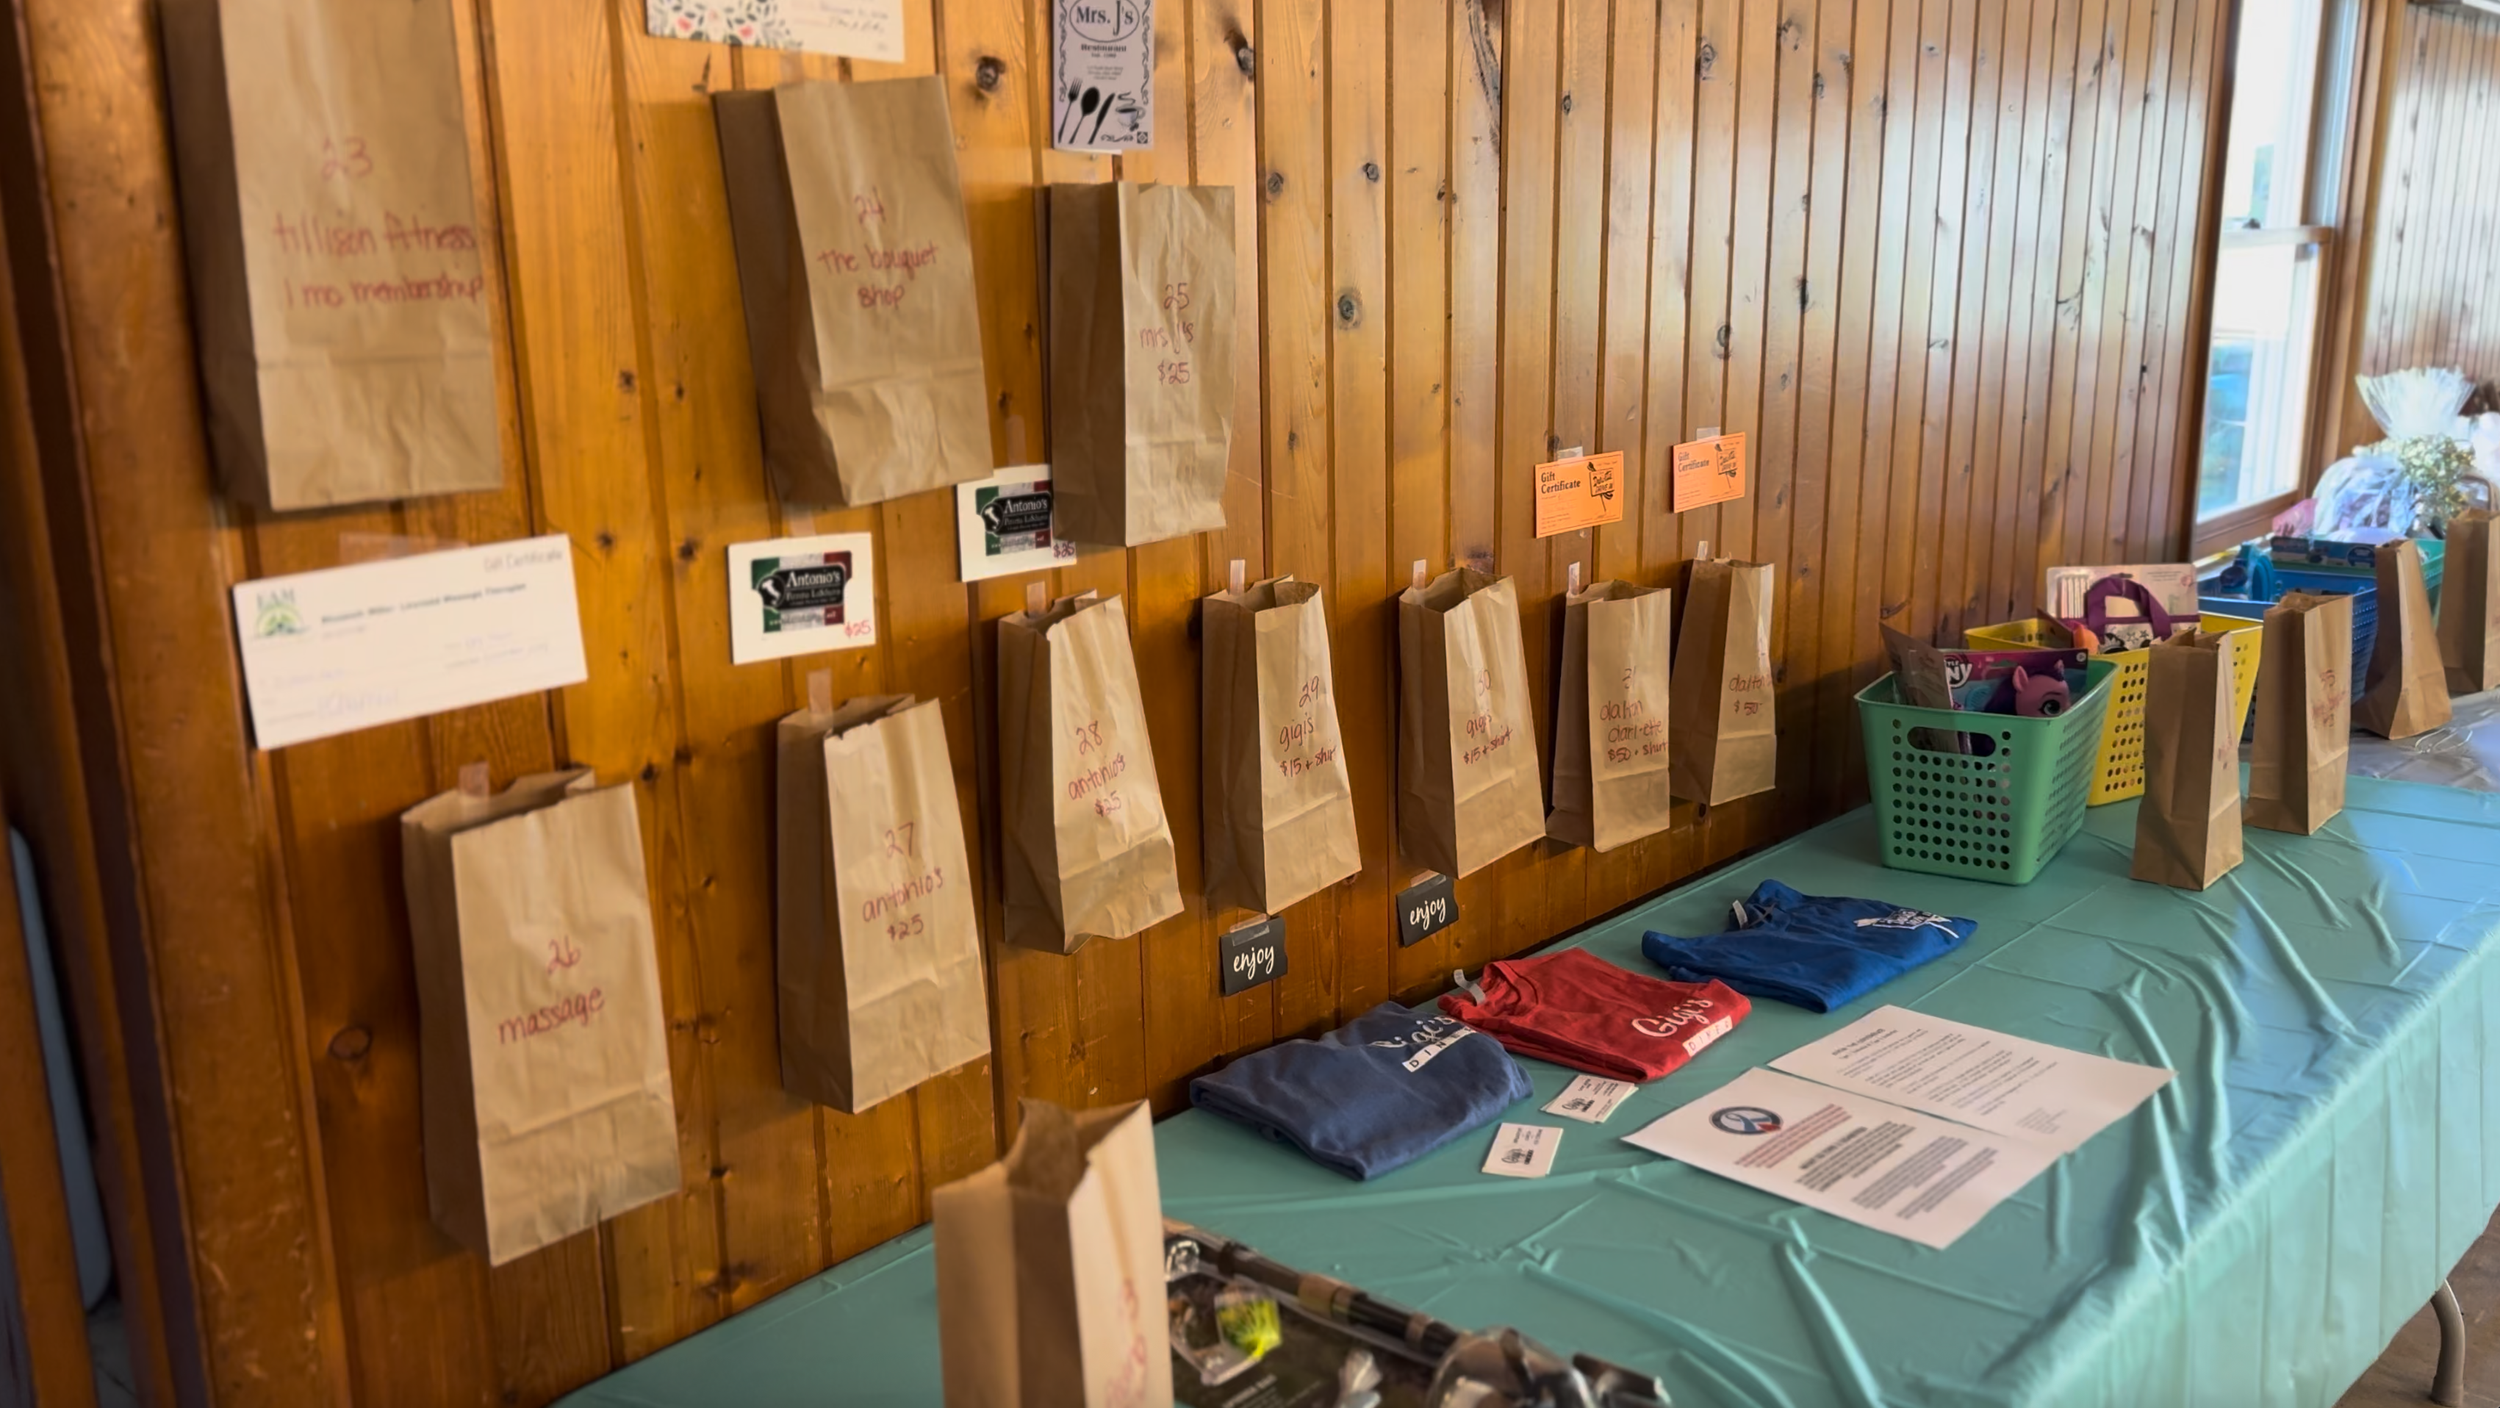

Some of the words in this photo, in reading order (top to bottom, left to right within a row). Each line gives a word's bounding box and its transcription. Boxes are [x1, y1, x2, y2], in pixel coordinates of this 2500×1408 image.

[1076, 6, 1110, 24] Mrs.
[1112, 0, 1133, 36] J's
[321, 137, 373, 180] 23
[855, 187, 887, 224] 24
[866, 244, 939, 280] bouquet
[300, 283, 345, 308] mo
[1163, 282, 1190, 310] 25
[1157, 360, 1190, 386] $25
[1678, 451, 1690, 462] Gift
[1678, 460, 1710, 472] Certificate
[1541, 471, 1556, 483] Gift
[1541, 480, 1581, 494] Certificate
[1003, 499, 1048, 514] Antonio's
[786, 570, 841, 588] Antonio's
[844, 619, 872, 640] $25
[1298, 675, 1320, 708] 29
[1075, 720, 1103, 756] 28
[1279, 756, 1302, 778] $15
[1462, 746, 1481, 765] $15
[1607, 746, 1632, 764] $50
[1094, 790, 1123, 818] $25
[884, 820, 915, 859] 27
[886, 913, 926, 943] $25
[1409, 897, 1446, 931] enjoy
[1233, 945, 1274, 980] enjoy
[498, 987, 606, 1044] massage
[1631, 999, 1714, 1037] Gigi's
